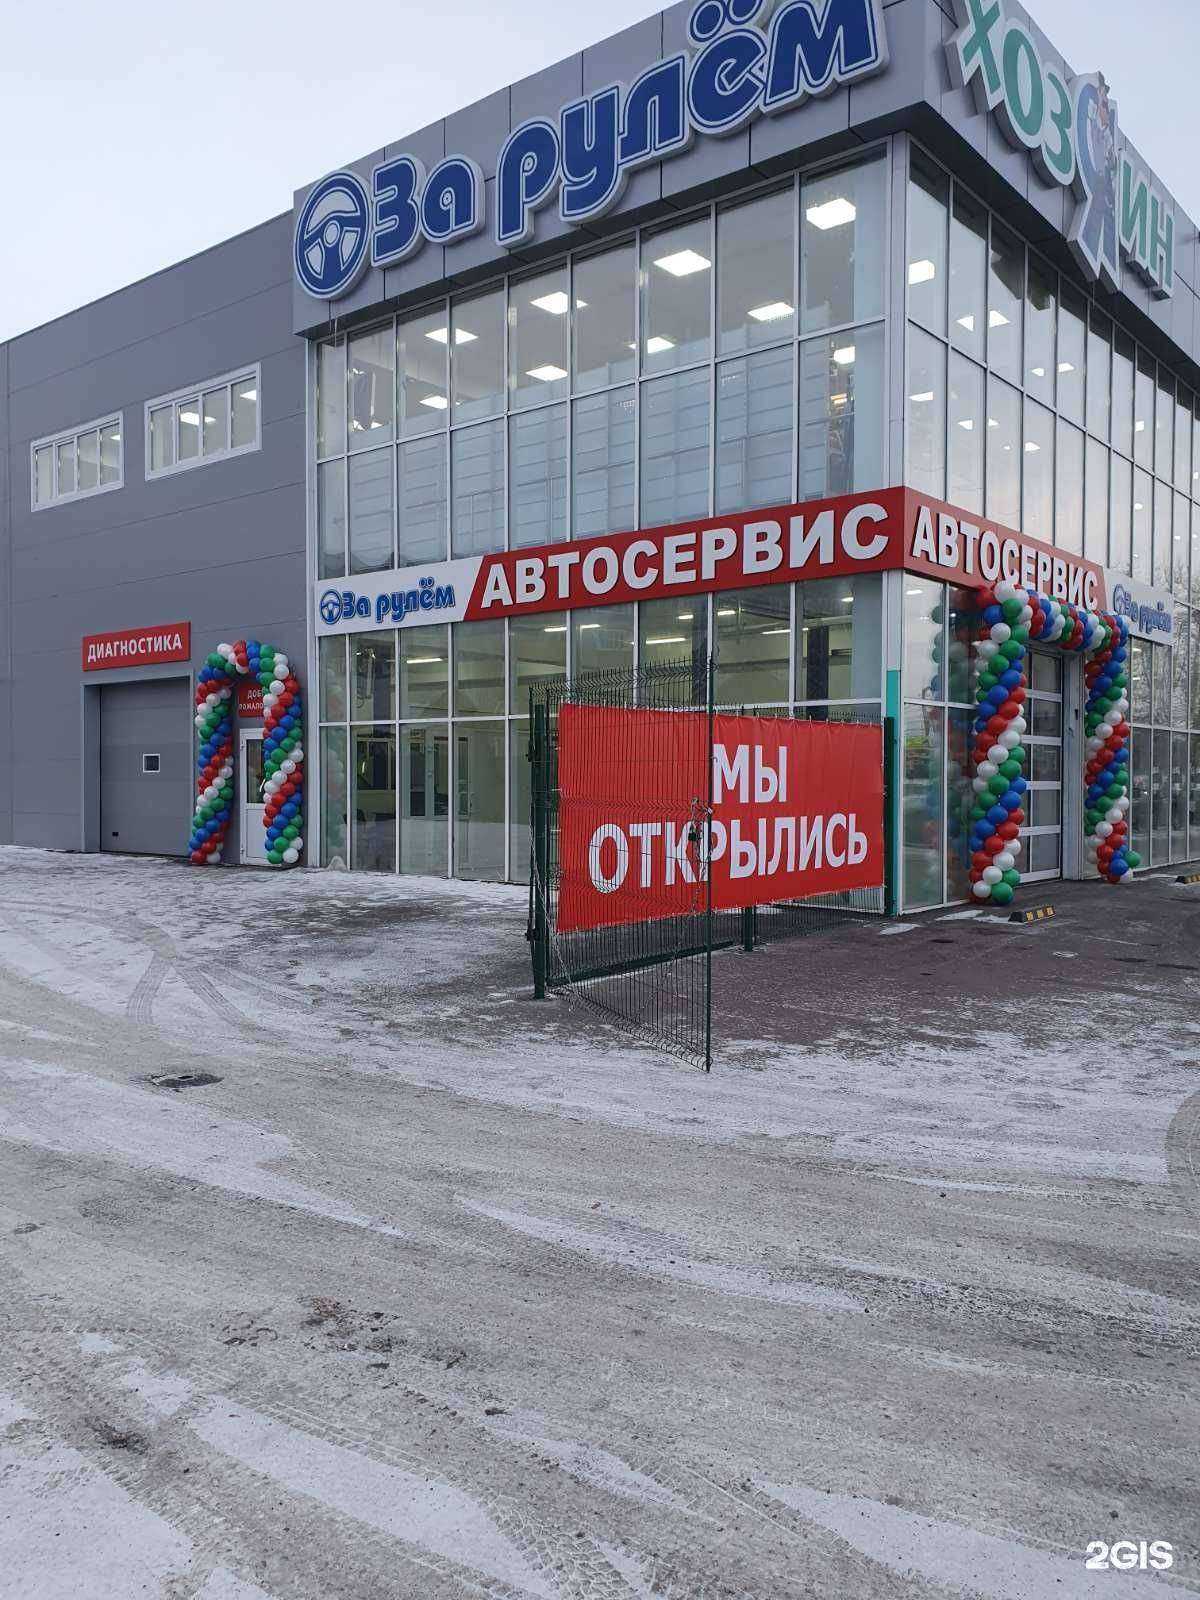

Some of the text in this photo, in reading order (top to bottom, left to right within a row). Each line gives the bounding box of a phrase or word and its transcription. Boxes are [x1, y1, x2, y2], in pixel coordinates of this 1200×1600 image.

[371, 0, 879, 265] За рулём
[480, 502, 890, 609] АВТОСЕРВИС
[912, 504, 1099, 611] АВТОСЕРВИС
[341, 576, 457, 624] За рулём
[87, 633, 183, 663] ДИАГНОСТИКА
[713, 743, 788, 804] МЫ
[588, 812, 869, 894] ОТКРЫЛИСЬ
